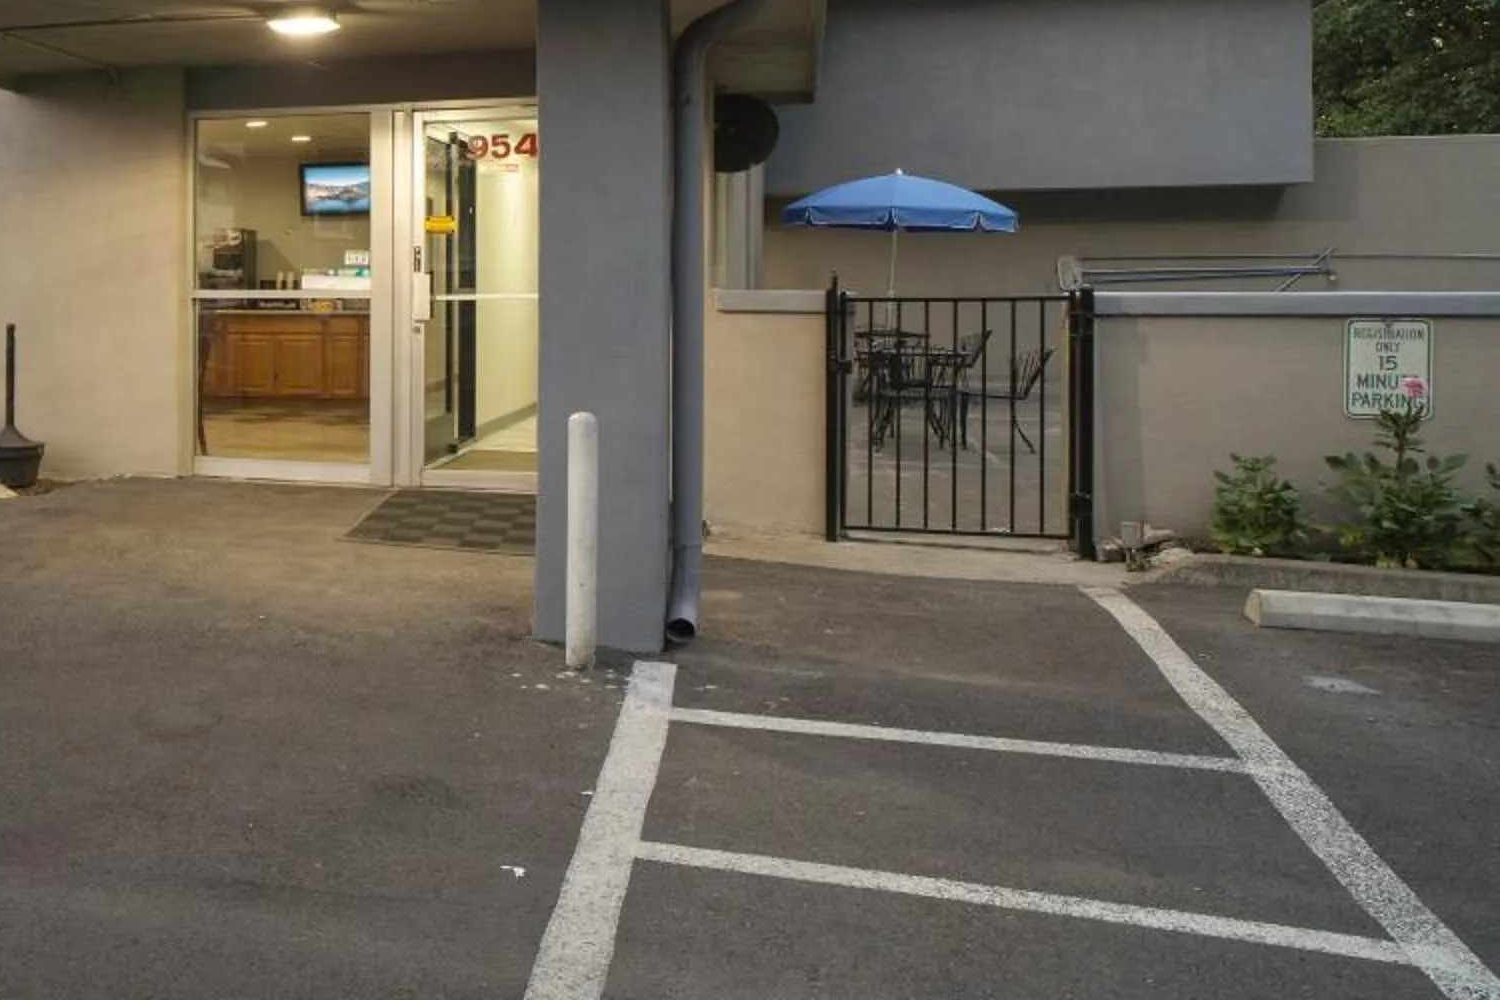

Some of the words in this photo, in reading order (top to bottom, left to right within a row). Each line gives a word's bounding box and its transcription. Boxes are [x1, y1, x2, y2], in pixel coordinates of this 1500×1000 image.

[467, 132, 538, 160] 954
[1375, 341, 1400, 353] ONLY
[1378, 355, 1398, 371] 15
[1356, 373, 1420, 390] MINU
